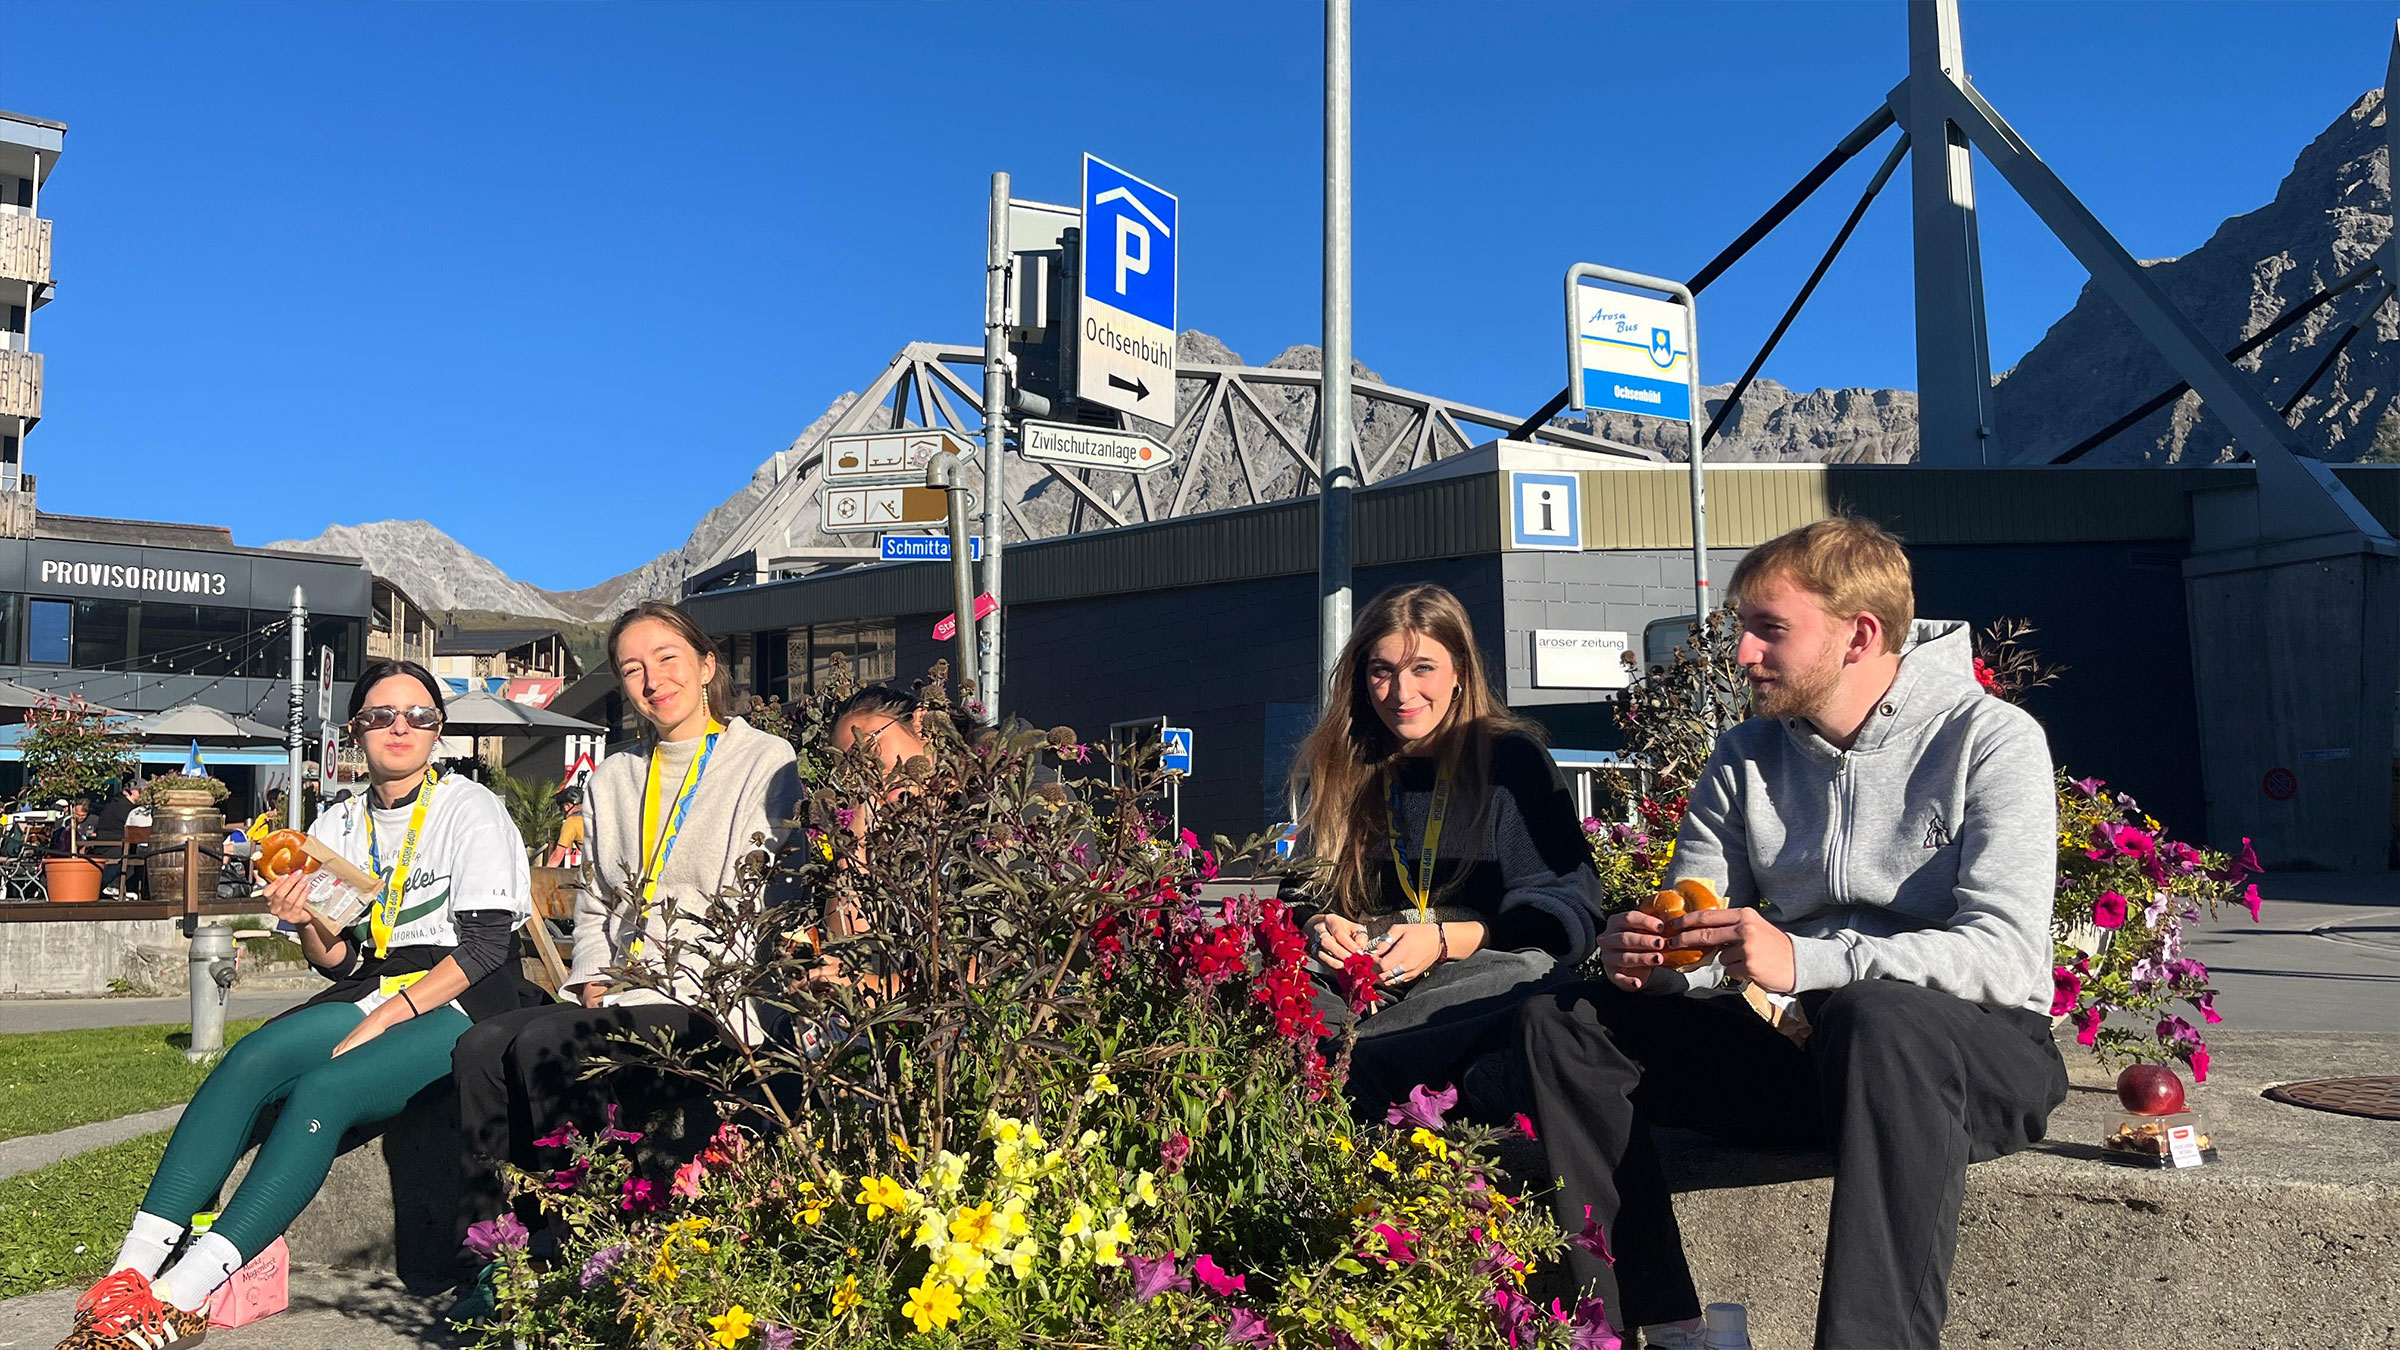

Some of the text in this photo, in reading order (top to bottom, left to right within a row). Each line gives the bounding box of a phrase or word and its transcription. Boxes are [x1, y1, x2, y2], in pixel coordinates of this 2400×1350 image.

[1115, 213, 1151, 296] P
[1588, 307, 1627, 324] Arosa
[1615, 320, 1639, 333] Bus
[1086, 317, 1172, 370] Ochsenbühl
[1613, 384, 1662, 404] Ochsenbühl
[1031, 430, 1137, 464] Zivilschutzanlage
[887, 538, 975, 559] Schmittag
[41, 560, 227, 596] PROVISORIUM13
[938, 619, 956, 634] Sta
[1538, 636, 1625, 650] aroser zeitung
[401, 845, 413, 867] AROSA
[1421, 847, 1433, 891] HOPP AROSA
